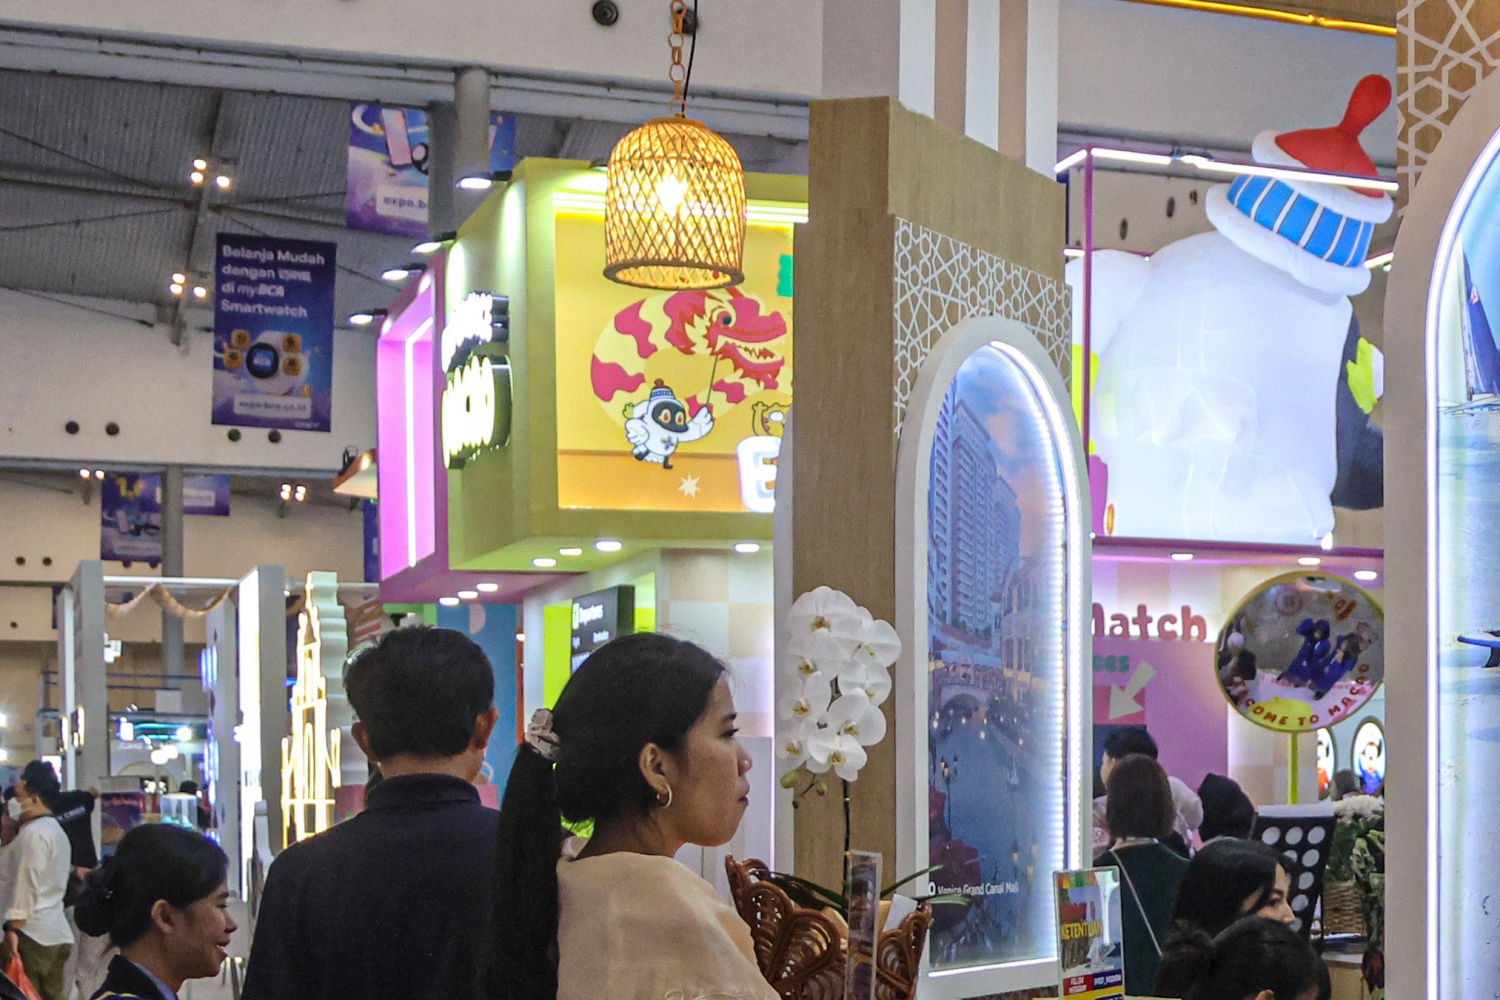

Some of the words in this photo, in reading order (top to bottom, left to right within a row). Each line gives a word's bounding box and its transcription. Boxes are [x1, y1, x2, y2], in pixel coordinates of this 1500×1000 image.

[223, 245, 274, 263] Belanja
[277, 250, 324, 265] Mudah
[222, 264, 275, 280] dengan
[222, 283, 234, 293] di
[222, 300, 307, 317] Smartwatch
[1298, 714, 1319, 726] TO
[963, 883, 984, 895] Grand
[985, 883, 1003, 894] Canal
[1006, 882, 1018, 893] Mall
